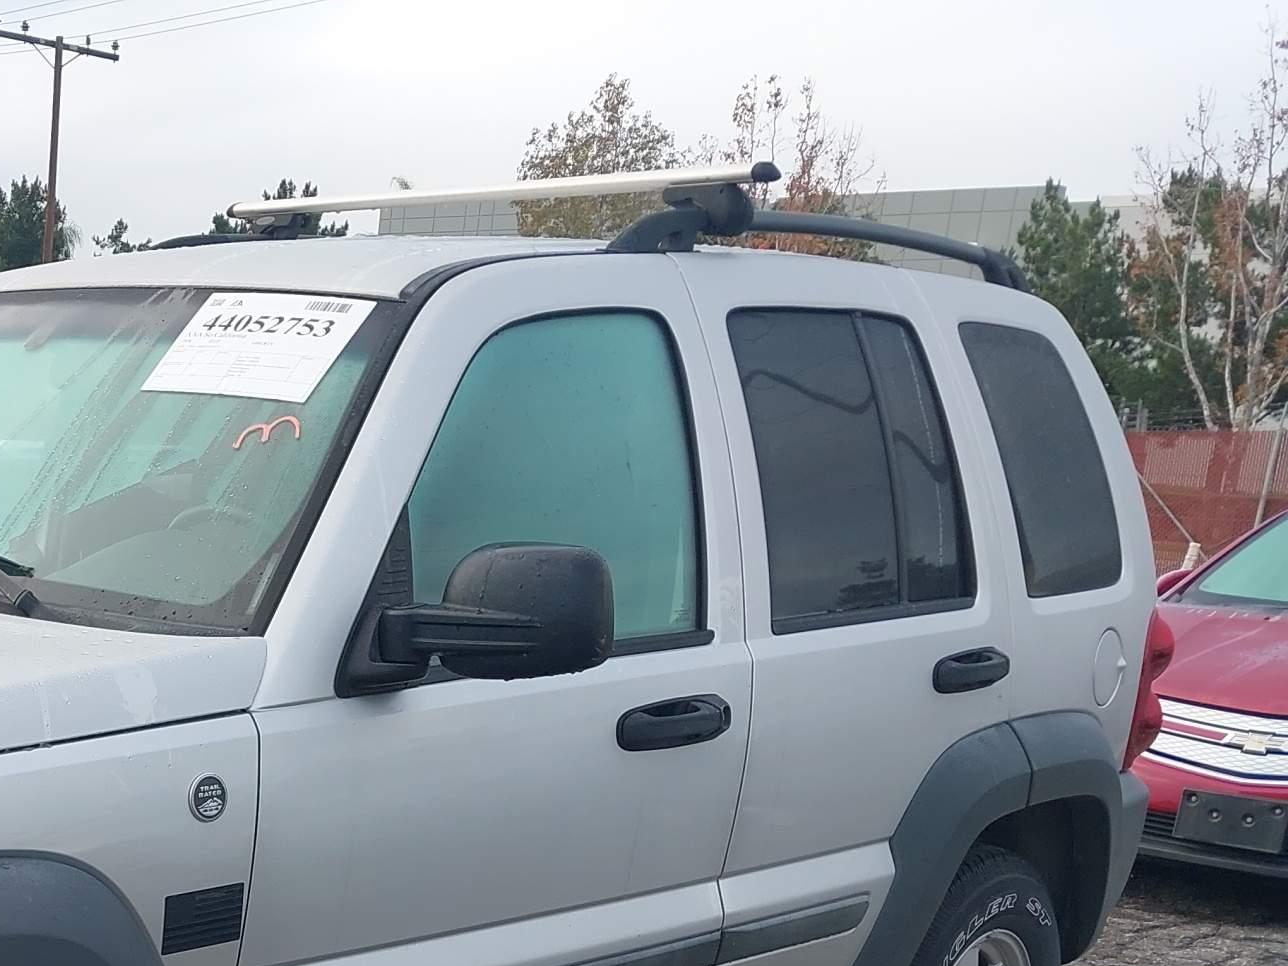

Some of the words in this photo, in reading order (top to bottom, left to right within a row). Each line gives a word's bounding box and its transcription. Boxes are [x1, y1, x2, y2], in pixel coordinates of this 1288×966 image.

[202, 313, 337, 338] 44052753
[198, 790, 222, 799] RATED
[199, 783, 221, 792] TRAIL
[1025, 897, 1053, 928] ST
